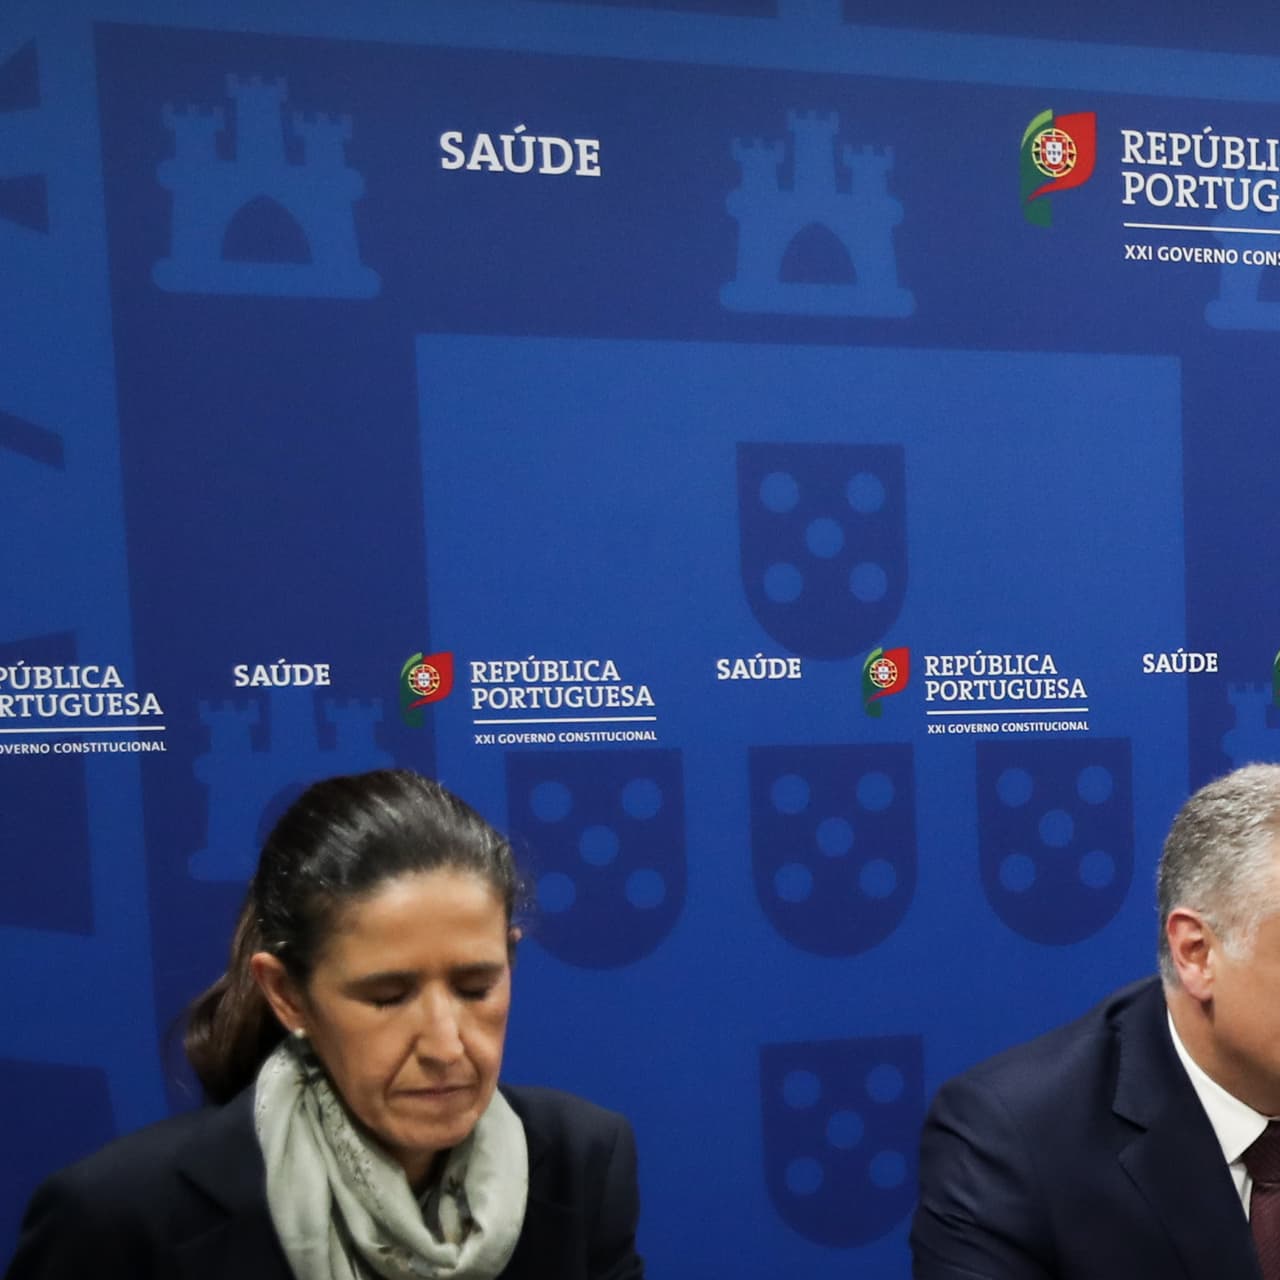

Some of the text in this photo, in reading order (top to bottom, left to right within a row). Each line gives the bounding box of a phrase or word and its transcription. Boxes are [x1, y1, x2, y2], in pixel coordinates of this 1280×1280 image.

[440, 124, 600, 176] SAÚDE
[1125, 244, 1152, 261] XXI
[1158, 246, 1238, 265] GOVERNO
[234, 659, 330, 686] SAÚDE
[470, 655, 621, 683] REPÚBLICA
[717, 653, 801, 679] SAÚDE
[924, 652, 1057, 676] REPÚBLICA
[1143, 648, 1217, 673] SAÚDE
[472, 686, 655, 709] PORTUGUESA
[925, 675, 1087, 701] PORTUGUESA
[475, 730, 656, 745] XXI GOVERNO CONSTITUCIONAL
[928, 720, 1089, 735] XXI GOVERNO CONSTITUCIONAL
[54, 741, 166, 754] CONSTITUCIONAL
